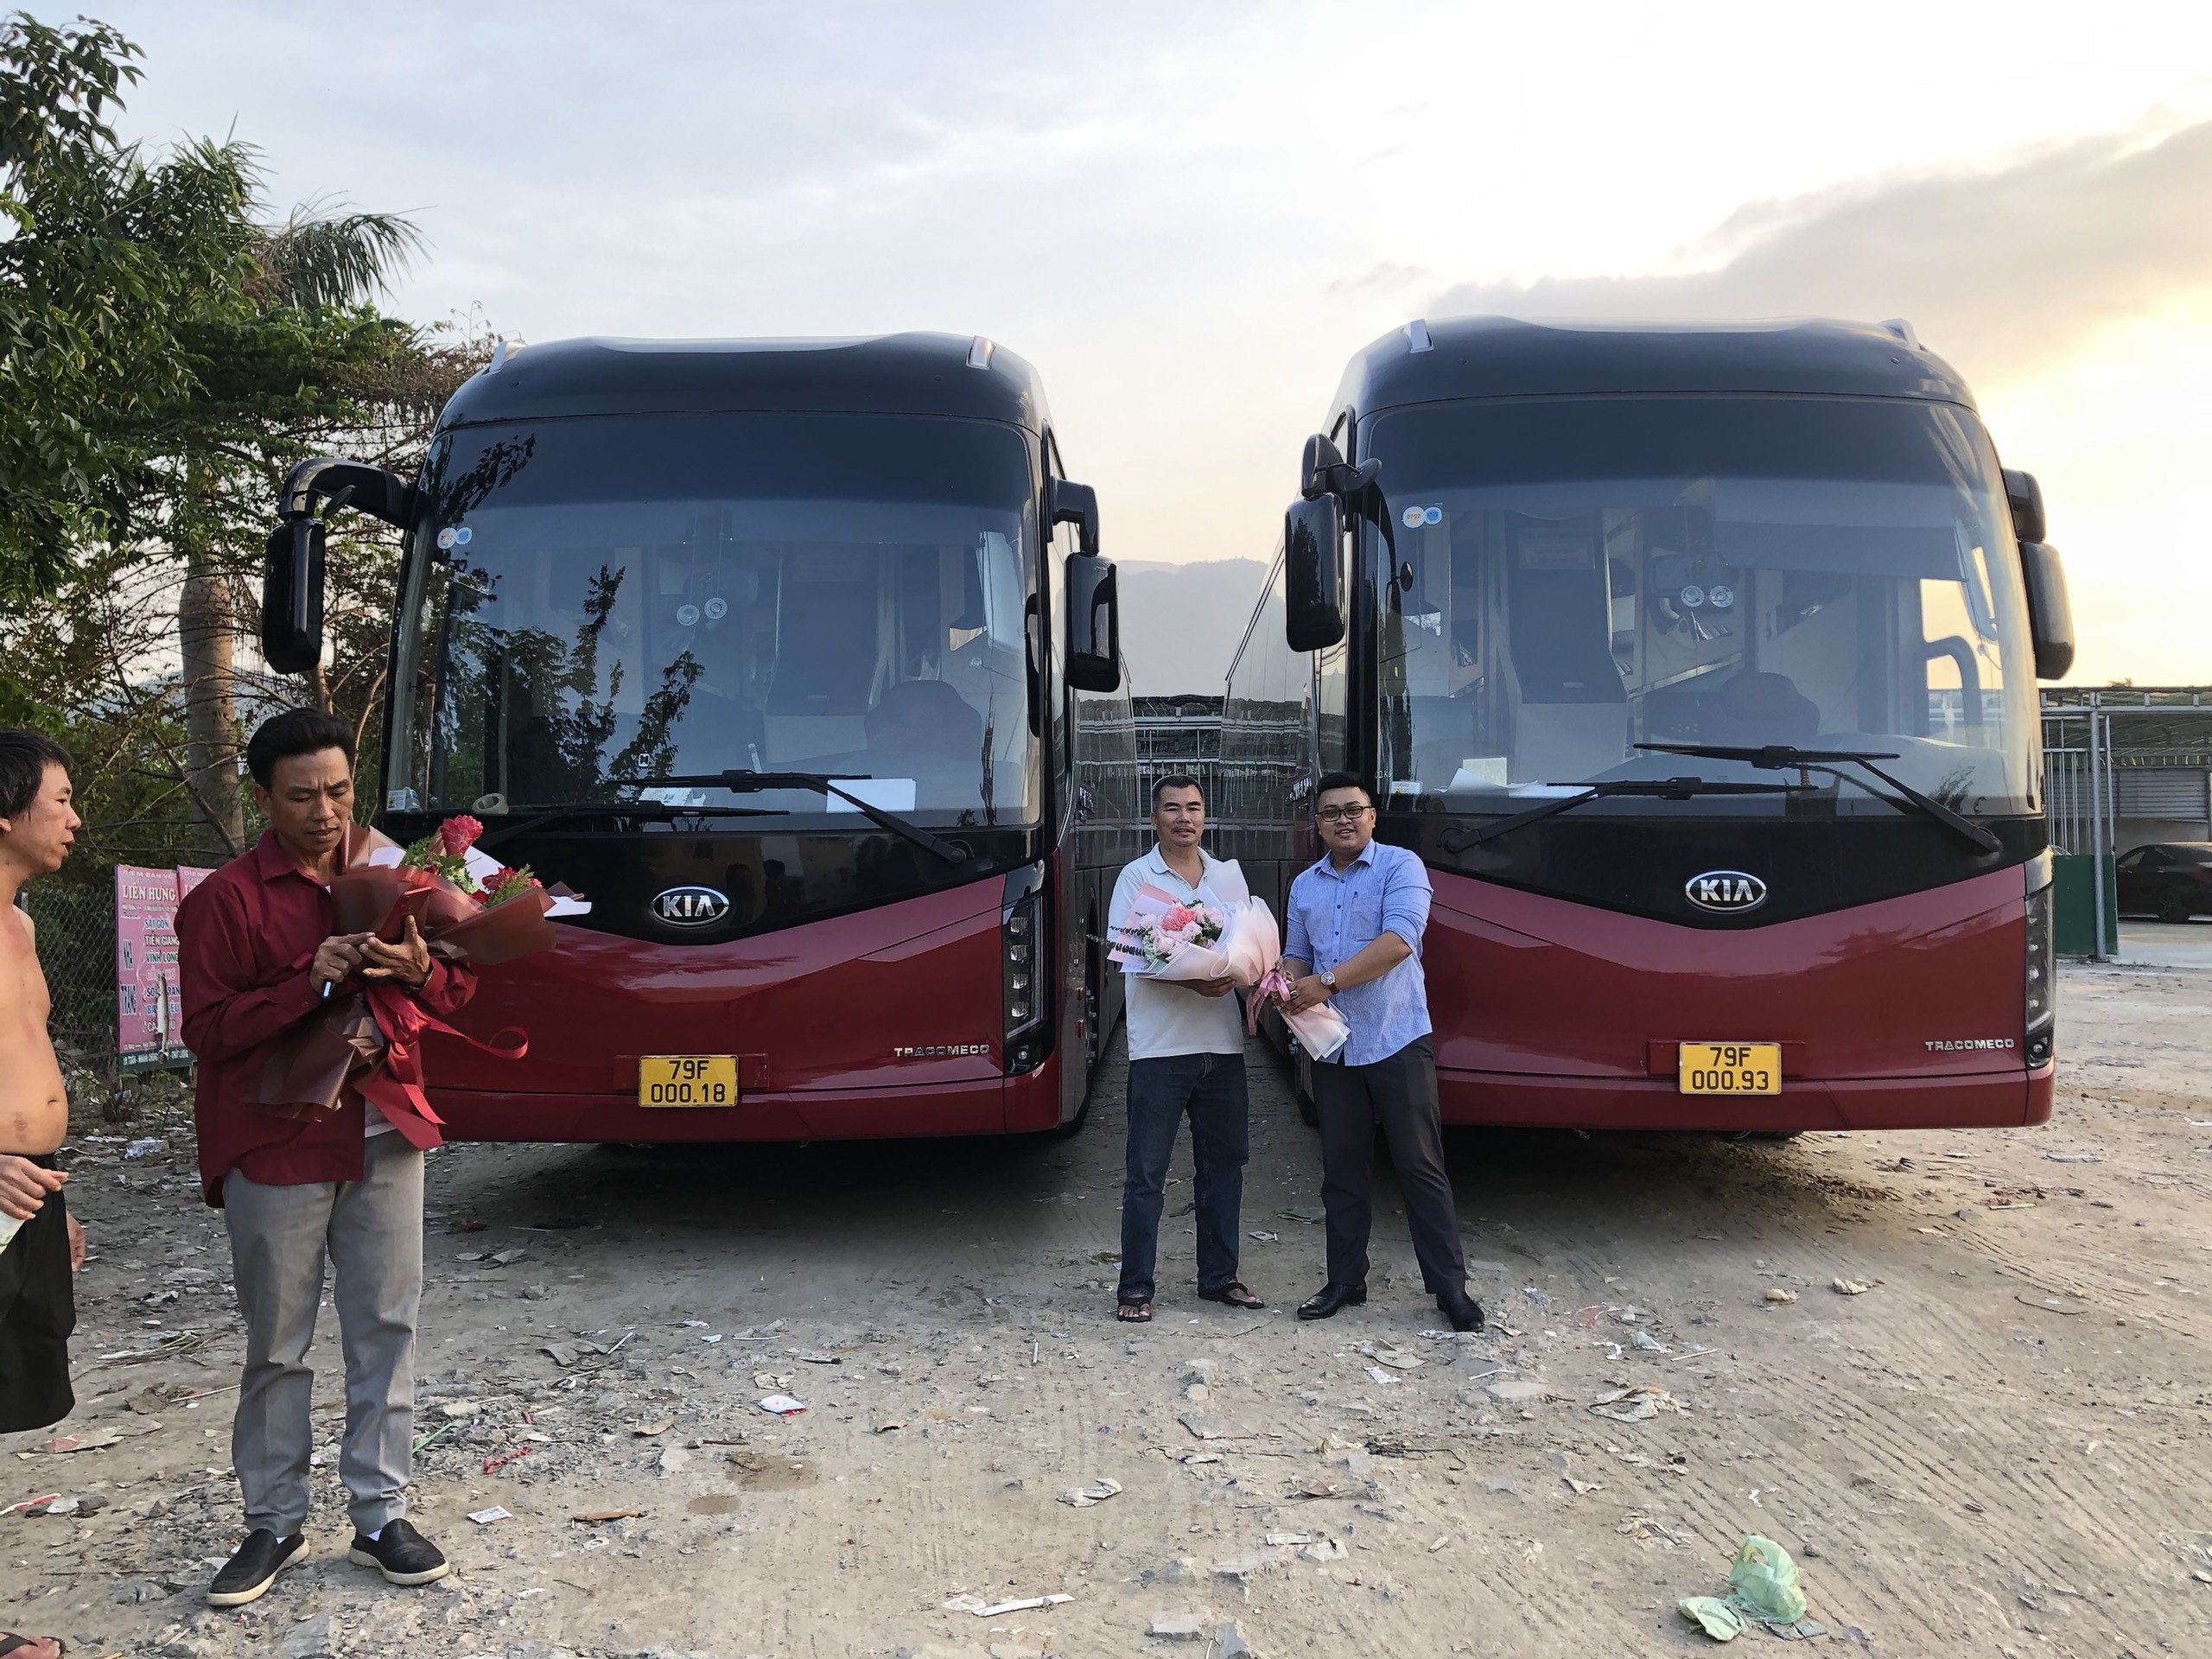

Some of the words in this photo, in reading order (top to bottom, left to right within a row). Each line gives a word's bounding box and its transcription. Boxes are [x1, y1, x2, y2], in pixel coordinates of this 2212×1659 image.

[123, 882, 146, 899] LIÊN
[1700, 879, 1754, 901] KIA
[662, 894, 715, 917] KIA
[893, 1044, 990, 1057] TRACOMECO
[1924, 1039, 2015, 1052] TRACOMECO
[1709, 1046, 1751, 1067] 79F
[668, 1059, 709, 1080] 79F
[1692, 1070, 1769, 1090] 000.93
[651, 1083, 726, 1103] 000.18
